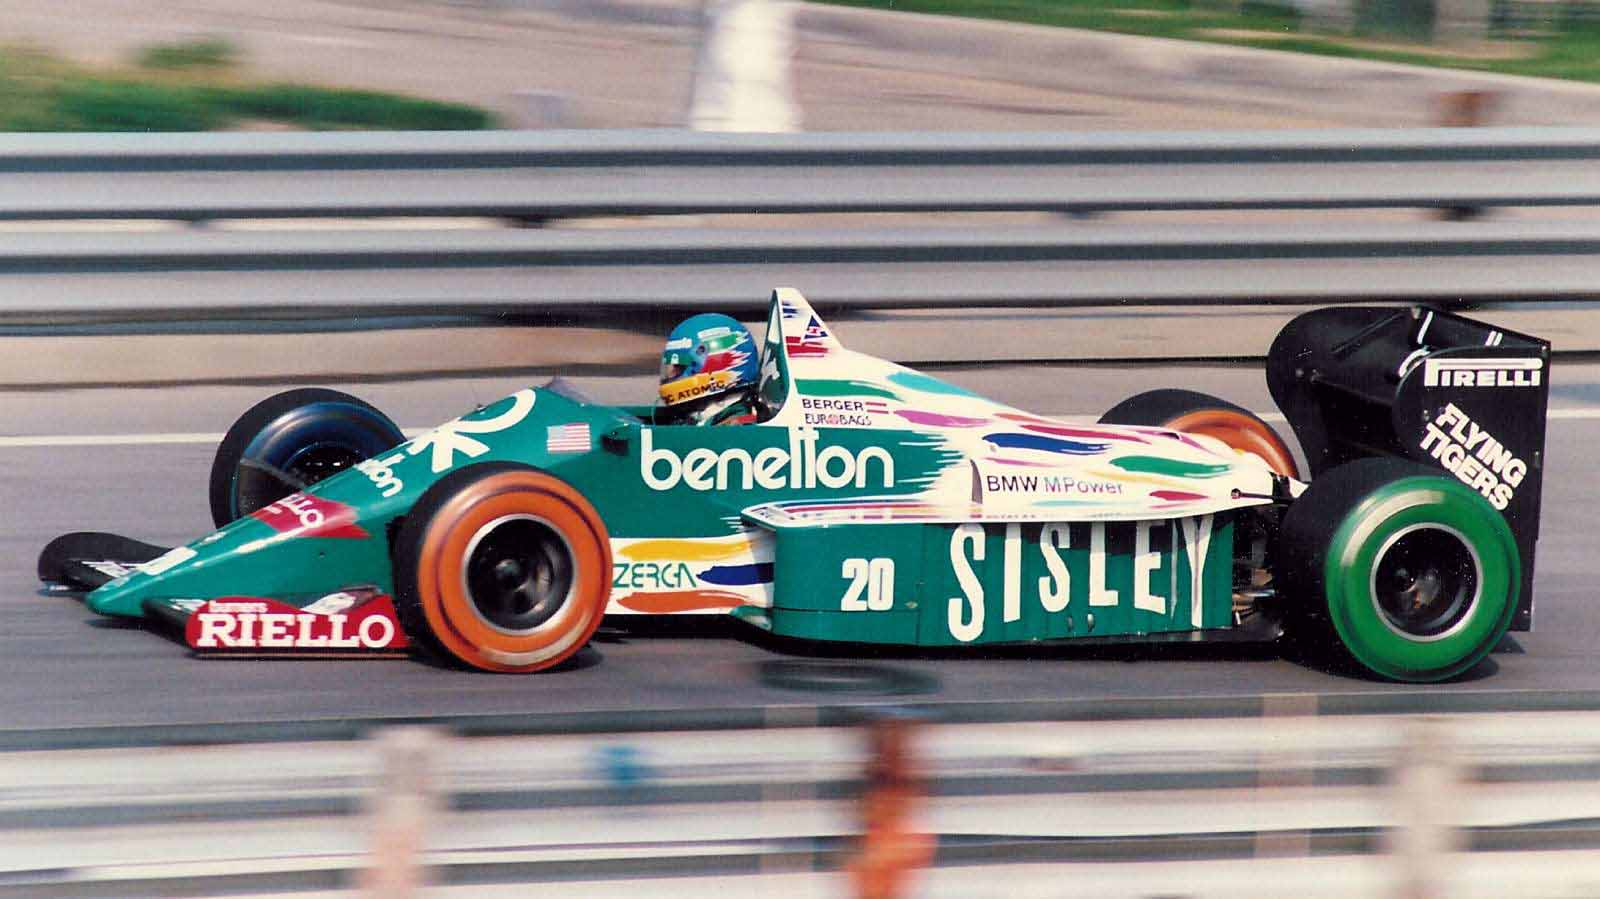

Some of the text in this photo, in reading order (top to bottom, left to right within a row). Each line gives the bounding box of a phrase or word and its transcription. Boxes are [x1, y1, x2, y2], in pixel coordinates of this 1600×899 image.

[1424, 358, 1543, 386] PIRELLI
[802, 398, 864, 411] BERGER
[640, 427, 895, 491] benetton
[1419, 422, 1514, 510] TIGERS
[1435, 402, 1528, 488] FLYING
[987, 475, 1038, 492] BMW
[841, 558, 896, 611] 20
[947, 513, 1214, 642] SISLEY
[197, 613, 395, 648] RIELLO
